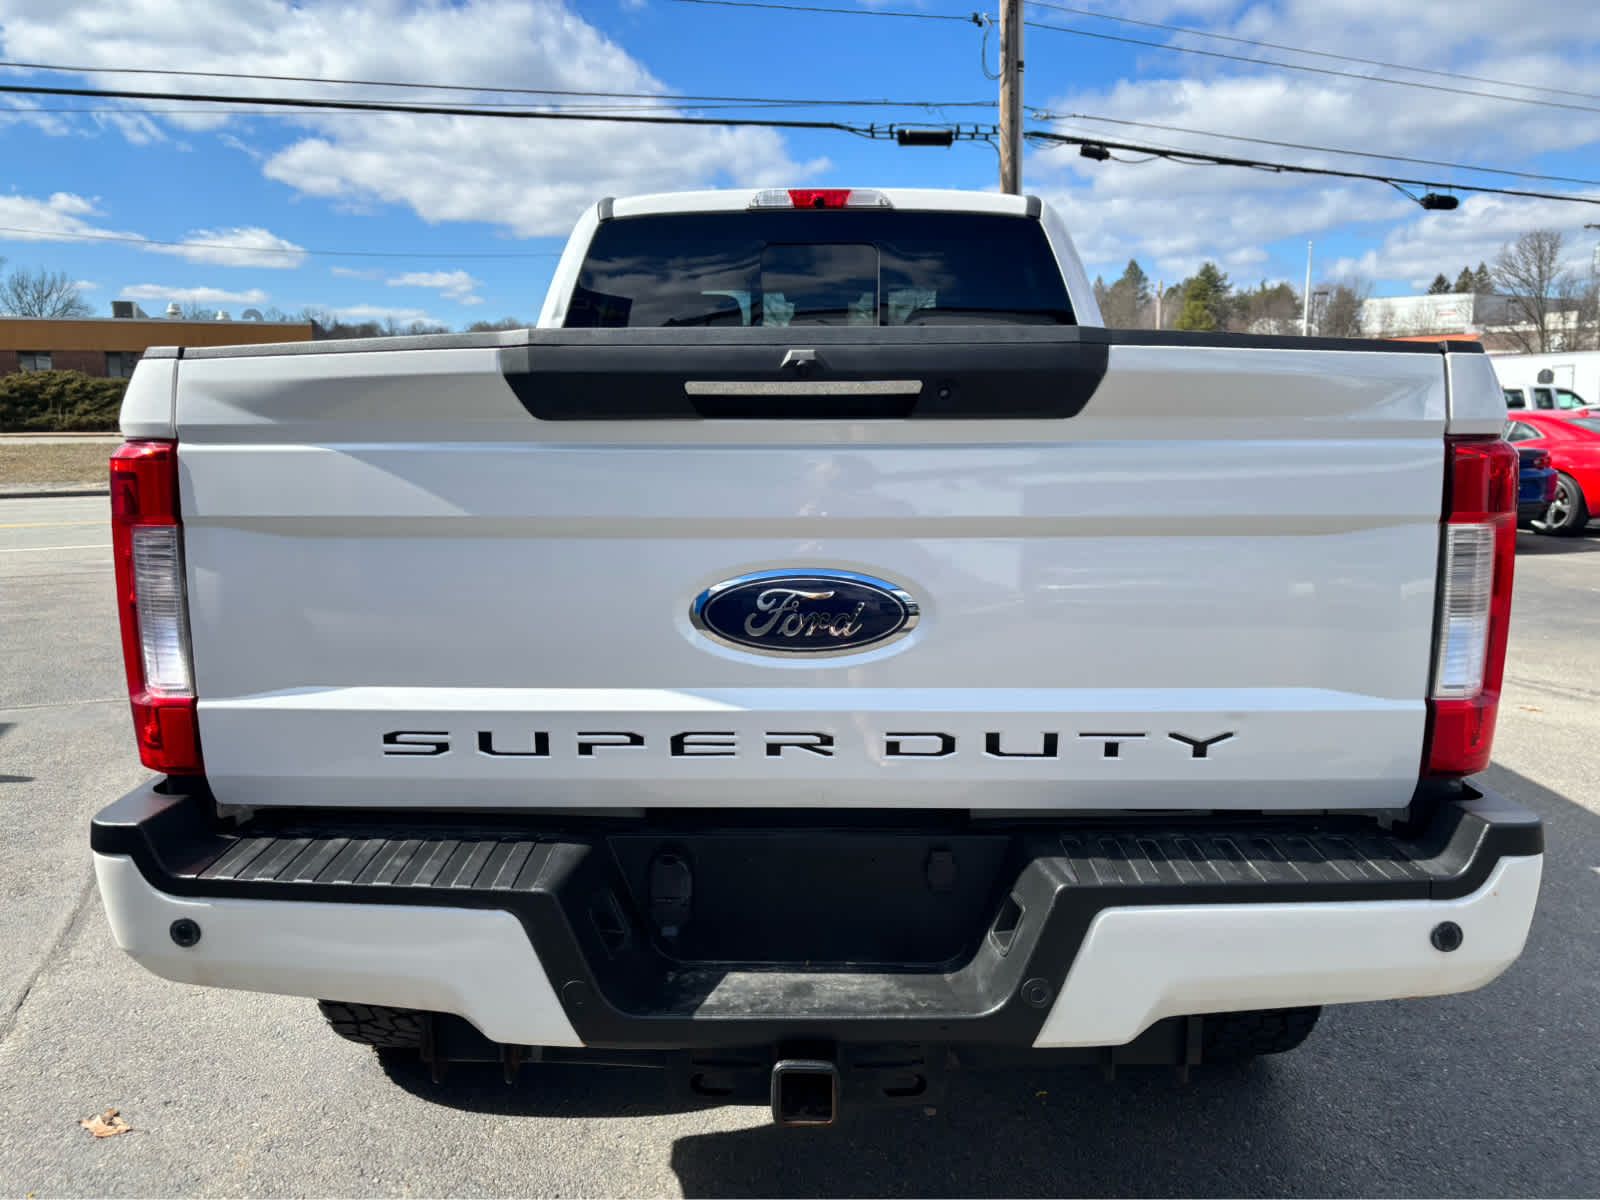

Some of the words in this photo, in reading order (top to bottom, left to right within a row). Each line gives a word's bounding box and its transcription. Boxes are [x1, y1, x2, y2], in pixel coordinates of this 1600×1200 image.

[743, 588, 865, 637] Ford
[382, 730, 835, 758] SUPER
[885, 731, 1235, 759] DUTY
